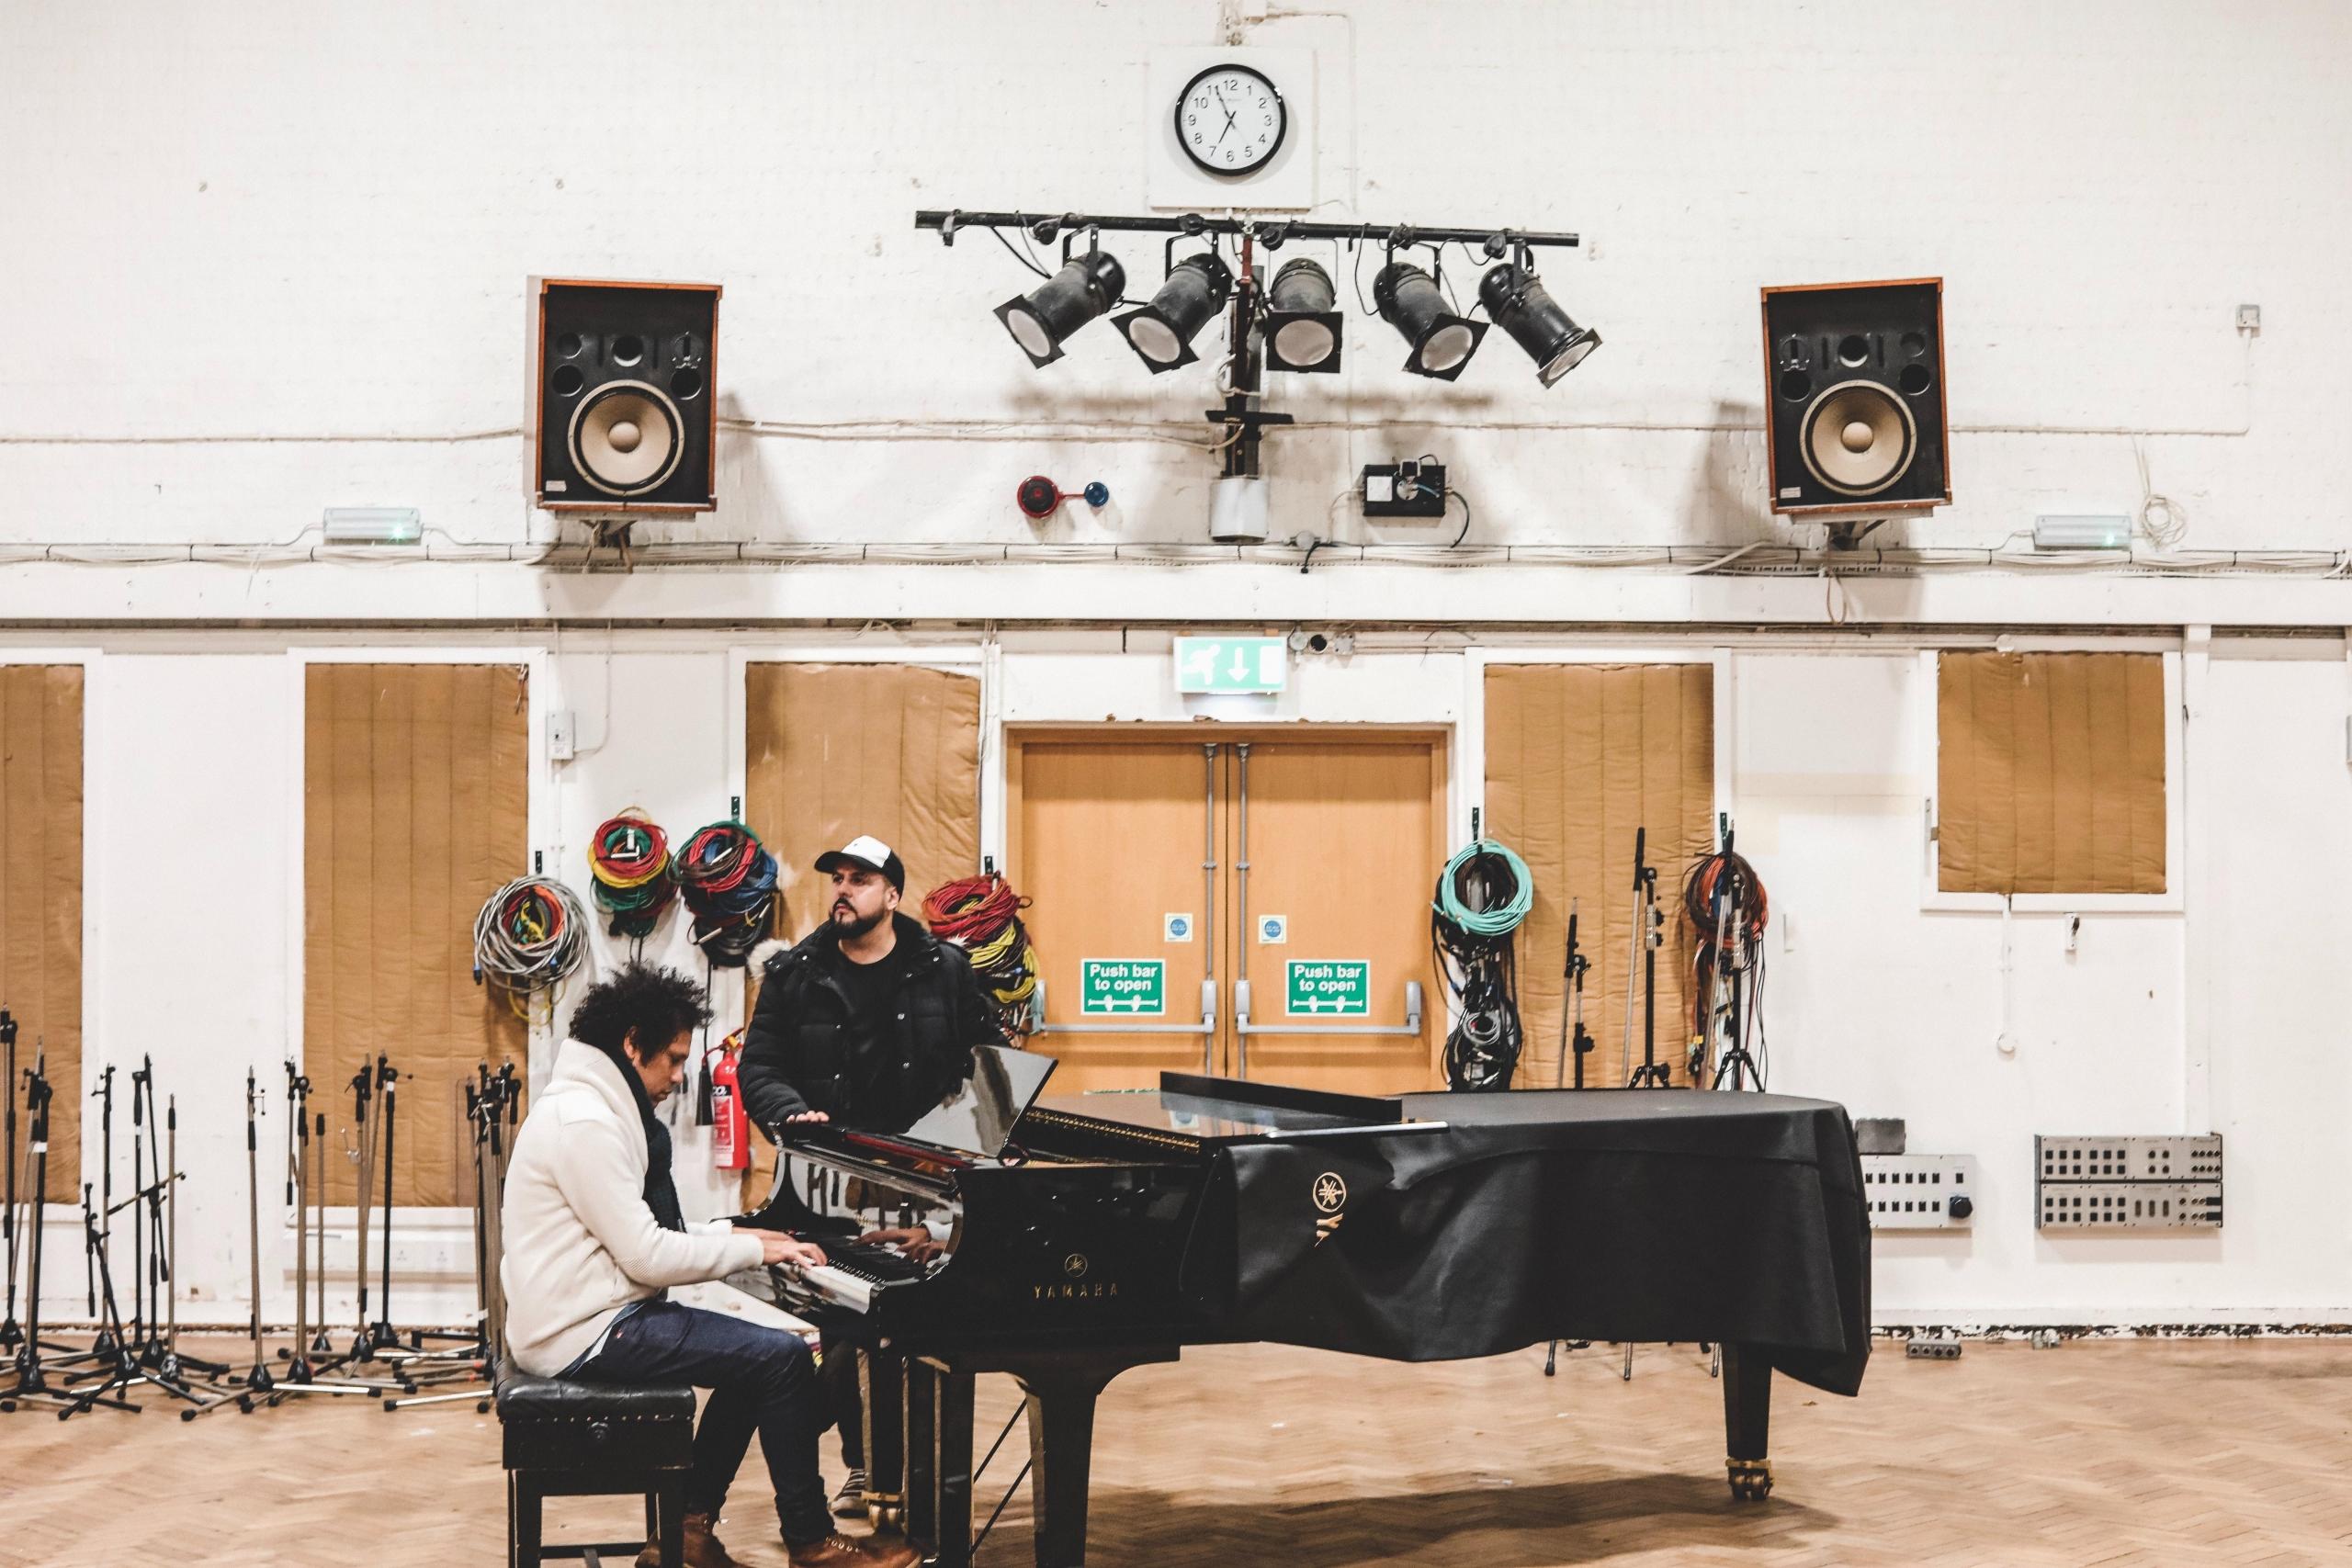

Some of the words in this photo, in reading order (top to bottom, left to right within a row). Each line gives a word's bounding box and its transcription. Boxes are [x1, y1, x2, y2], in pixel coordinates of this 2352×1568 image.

[1206, 85, 1219, 96] 11
[1224, 79, 1238, 91] 12
[1247, 85, 1252, 96] 1
[1194, 96, 1208, 109] 10
[1259, 96, 1267, 109] 2
[1188, 114, 1196, 126] 9
[1264, 115, 1272, 127] 3
[1194, 132, 1203, 144] 8
[1258, 133, 1266, 144] 4
[1209, 145, 1216, 156] 7
[1227, 150, 1234, 162] 6
[1244, 146, 1252, 158] 5
[1090, 964, 1128, 977] Push
[1132, 964, 1158, 977] bar
[1295, 964, 1332, 978] Push
[1337, 964, 1363, 978] bar
[1094, 977, 1111, 991] to
[1114, 979, 1152, 994] open
[1299, 978, 1315, 991] to
[1318, 980, 1356, 995] open
[1034, 1282, 1118, 1299] YAMAHA
